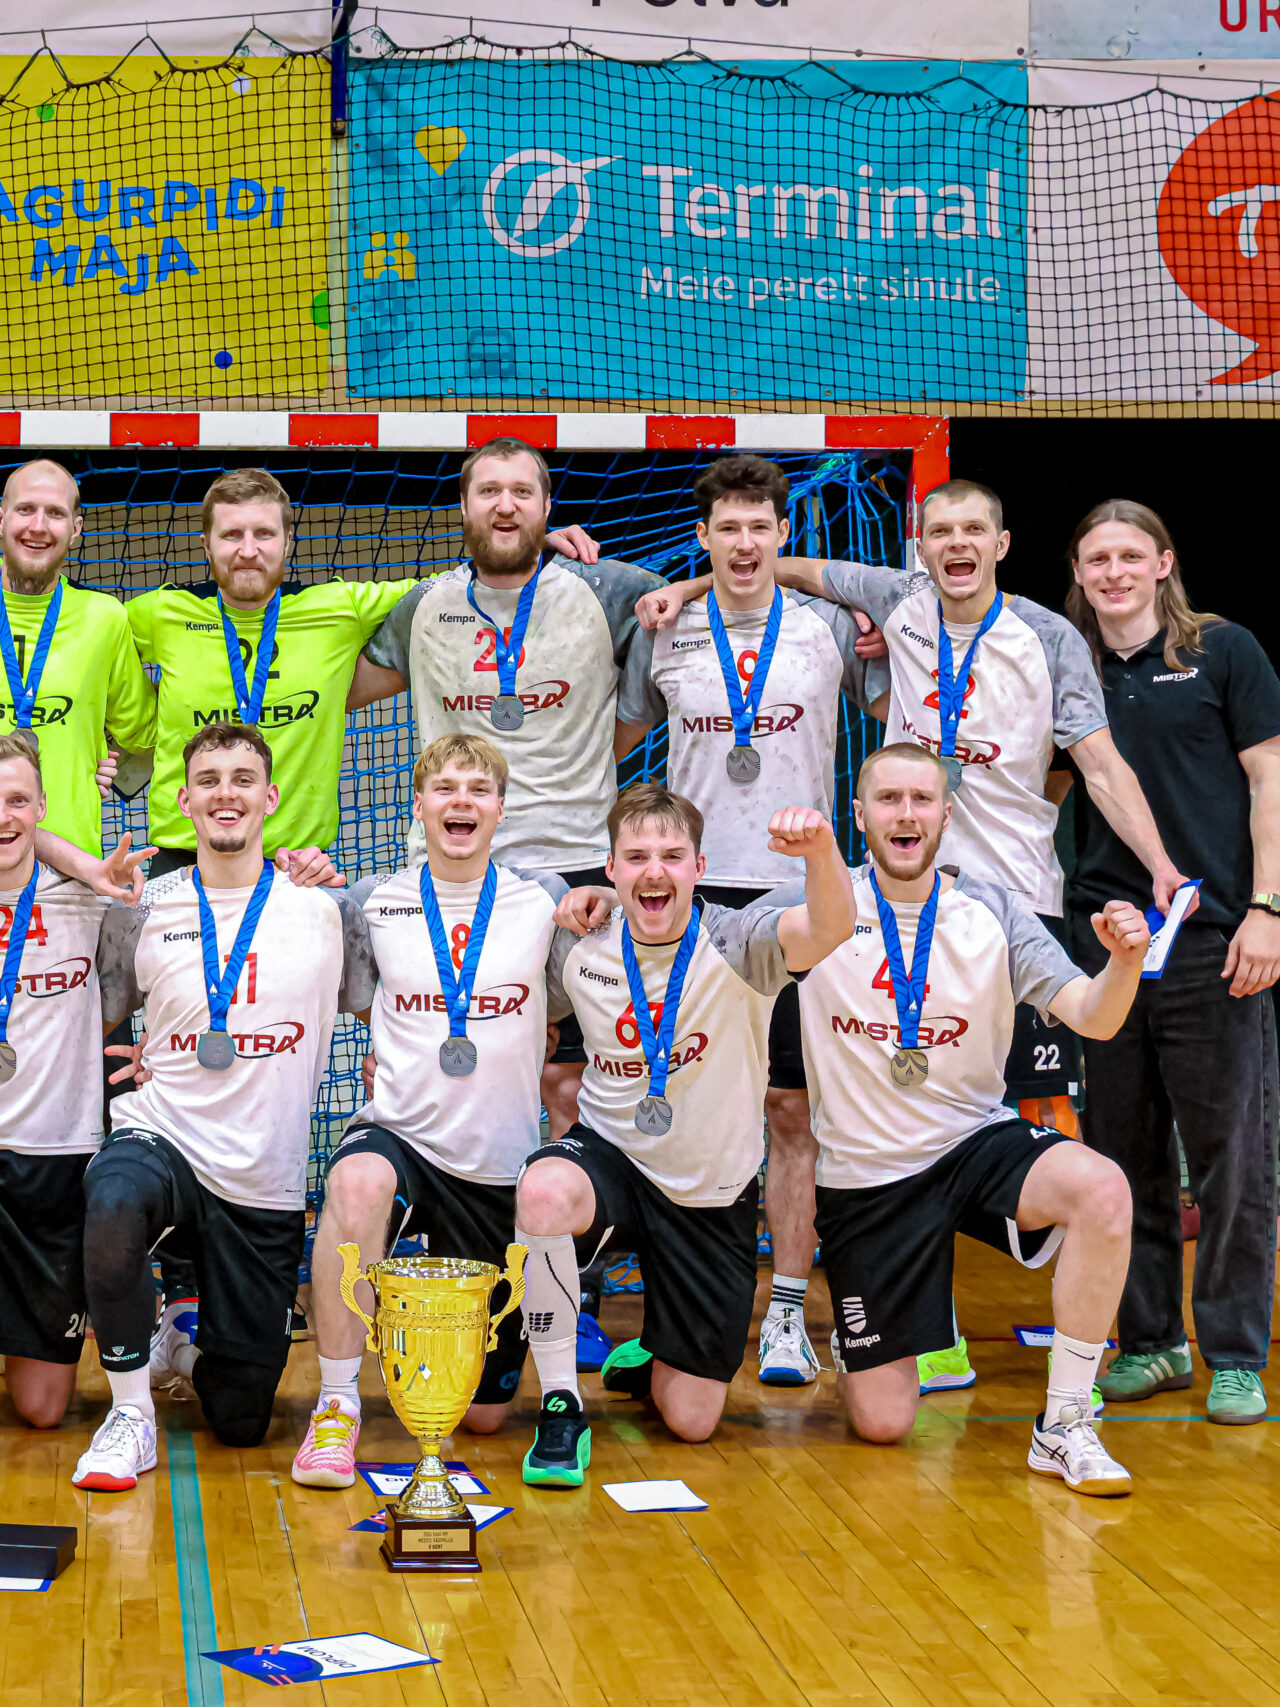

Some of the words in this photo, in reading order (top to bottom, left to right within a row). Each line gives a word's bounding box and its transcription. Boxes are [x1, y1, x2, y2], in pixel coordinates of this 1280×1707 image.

[641, 164, 1002, 242] Terminal
[29, 235, 200, 296] MAJA
[640, 266, 735, 301] Meie
[880, 267, 1001, 302] sinule
[185, 621, 219, 633] Kempa
[438, 612, 476, 625] Kempa
[671, 637, 711, 650] Kempa
[900, 624, 934, 650] Kempa
[1152, 667, 1199, 684] MISTRA
[441, 692, 565, 713] MISRA
[681, 713, 797, 735] MISRA
[379, 906, 423, 917] Kempa
[163, 931, 202, 943] Kemp
[579, 966, 619, 987] Kempa
[871, 956, 931, 1002] 4
[170, 1031, 297, 1055] MTRA
[1033, 1045, 1061, 1071] 22
[529, 1325, 552, 1334] cep
[844, 1333, 881, 1349] Kempa
[296, 1645, 357, 1669] DIPLOM
